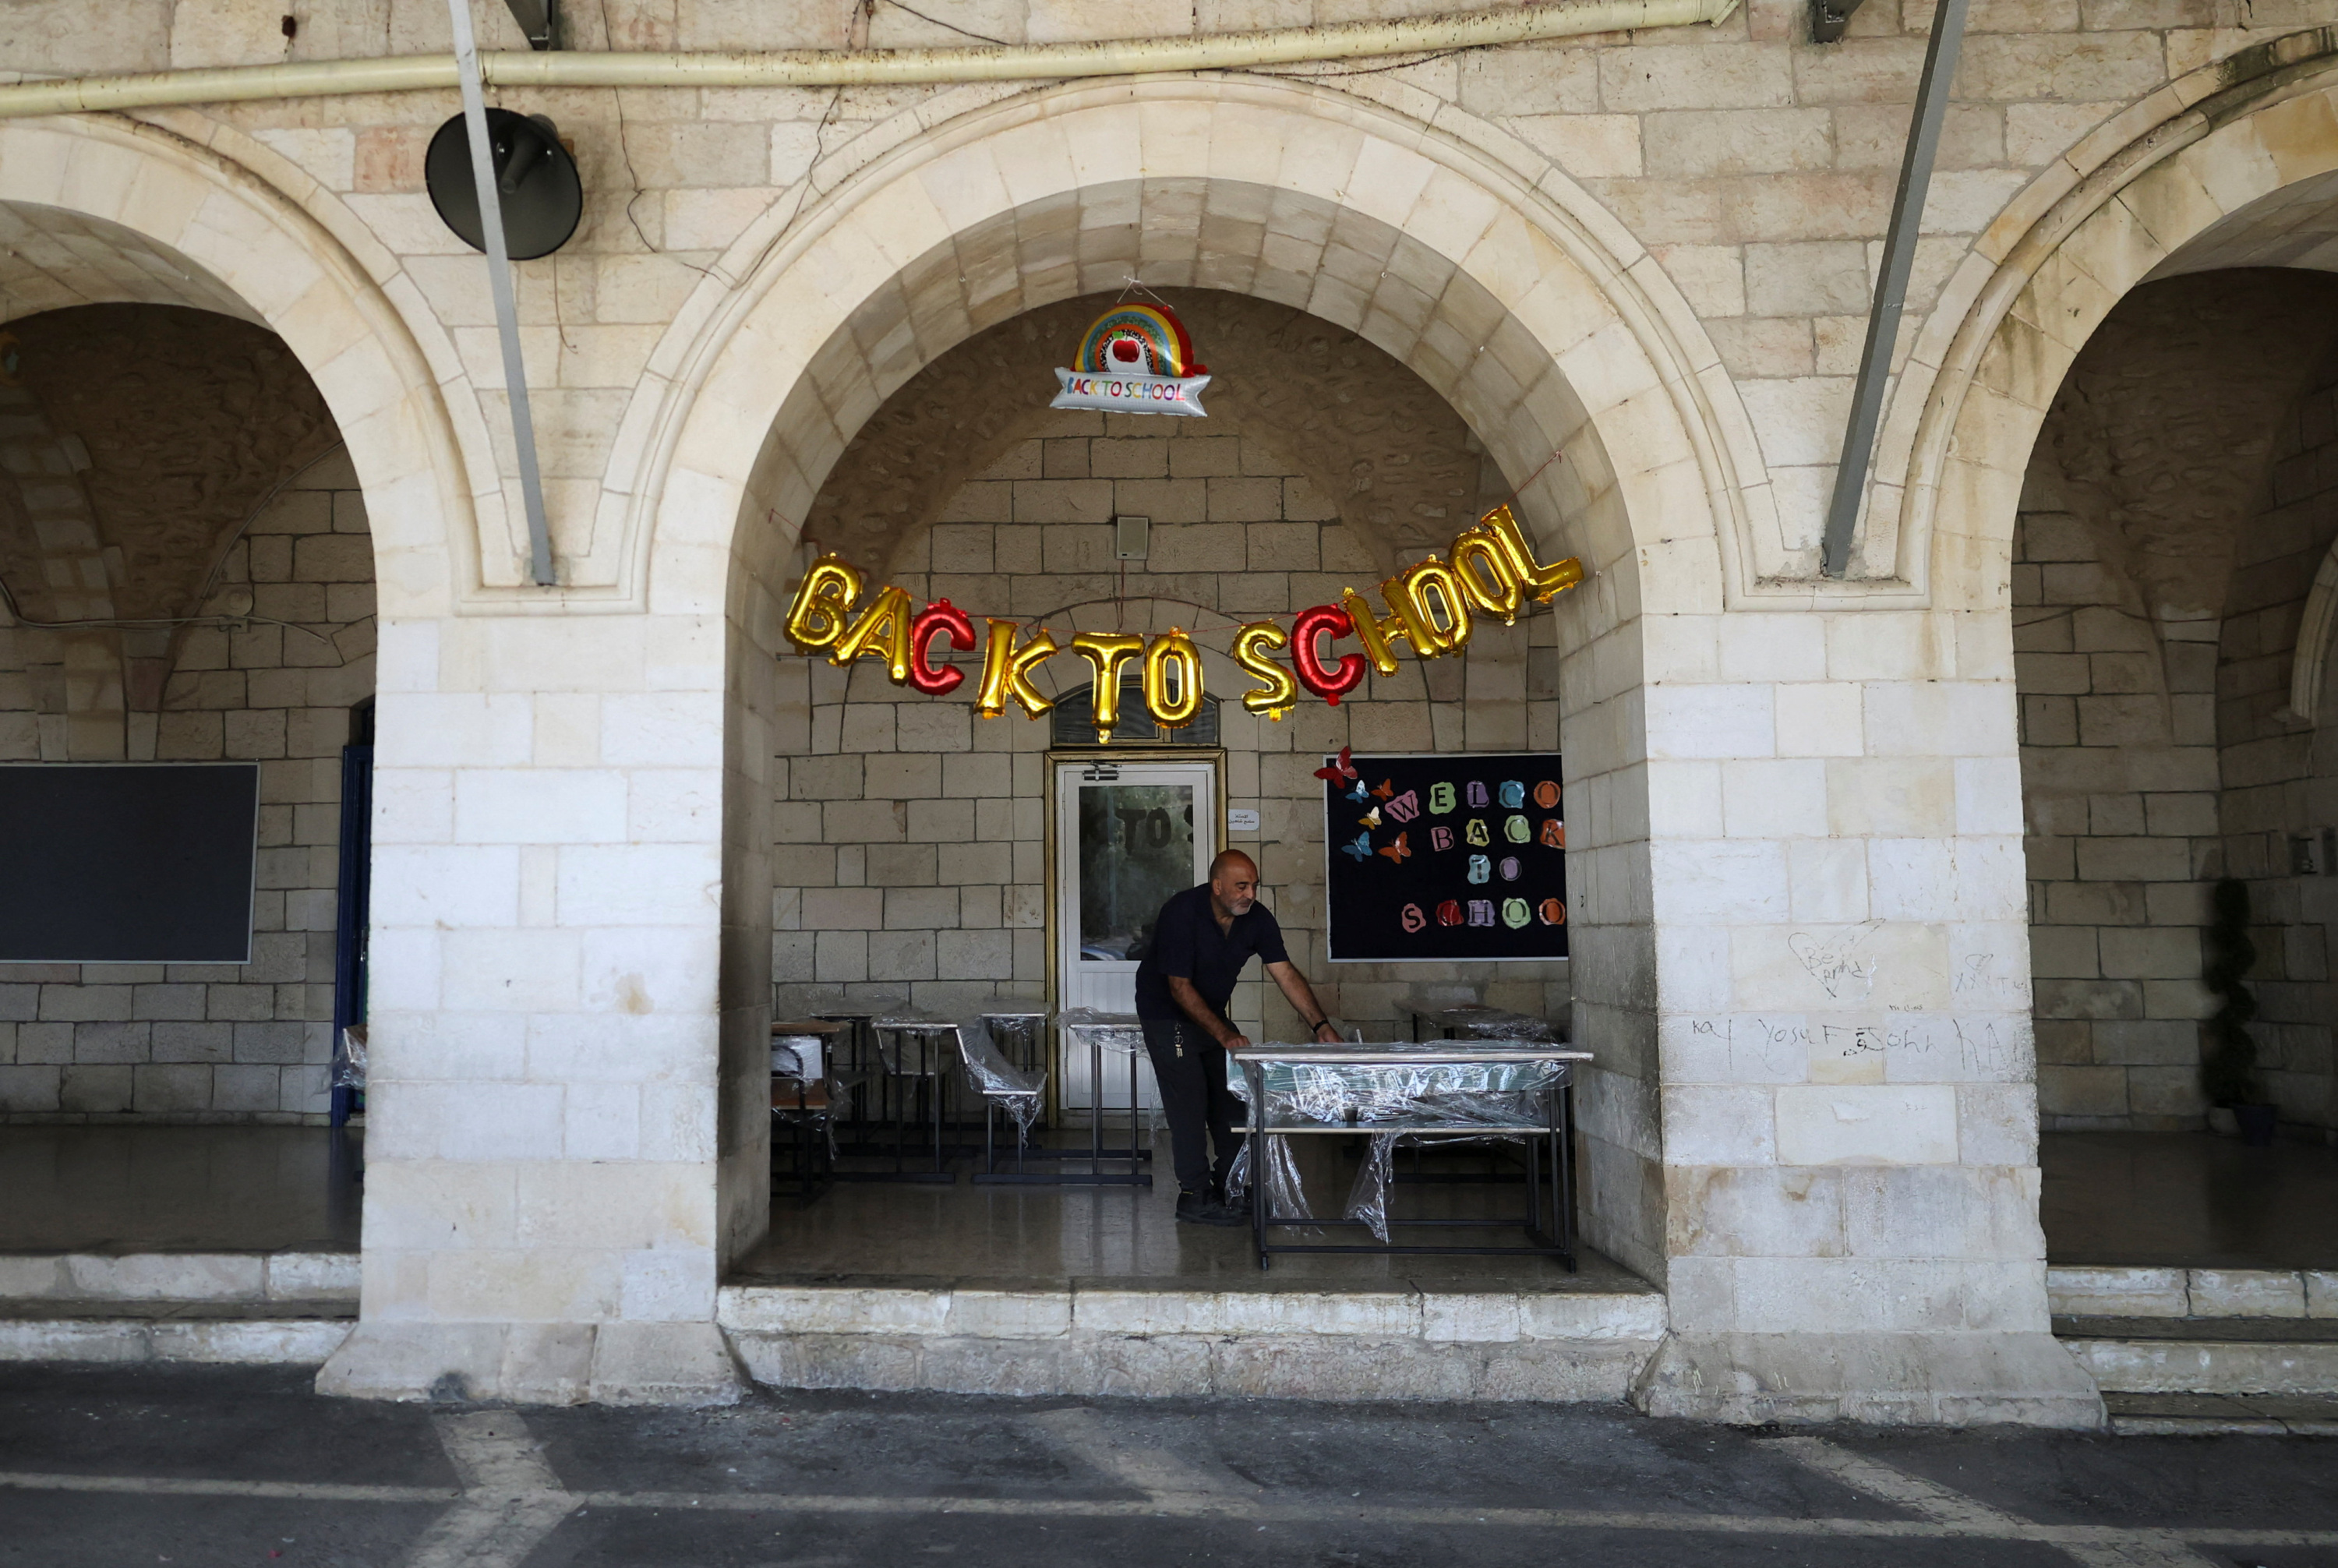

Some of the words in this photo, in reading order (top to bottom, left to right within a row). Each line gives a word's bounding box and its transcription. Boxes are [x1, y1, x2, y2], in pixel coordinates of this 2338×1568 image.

[1067, 376, 1098, 395] BACK
[1103, 380, 1122, 397] TO
[1125, 382, 1185, 401] SCHOOL
[783, 552, 1059, 721] BACK
[1071, 627, 1204, 742] TO
[1232, 503, 1584, 720] SCHOOL
[1386, 780, 1560, 822] WELCO
[1431, 817, 1564, 851] BACK
[1467, 855, 1521, 884] TO
[1403, 899, 1565, 932] SCHOO
